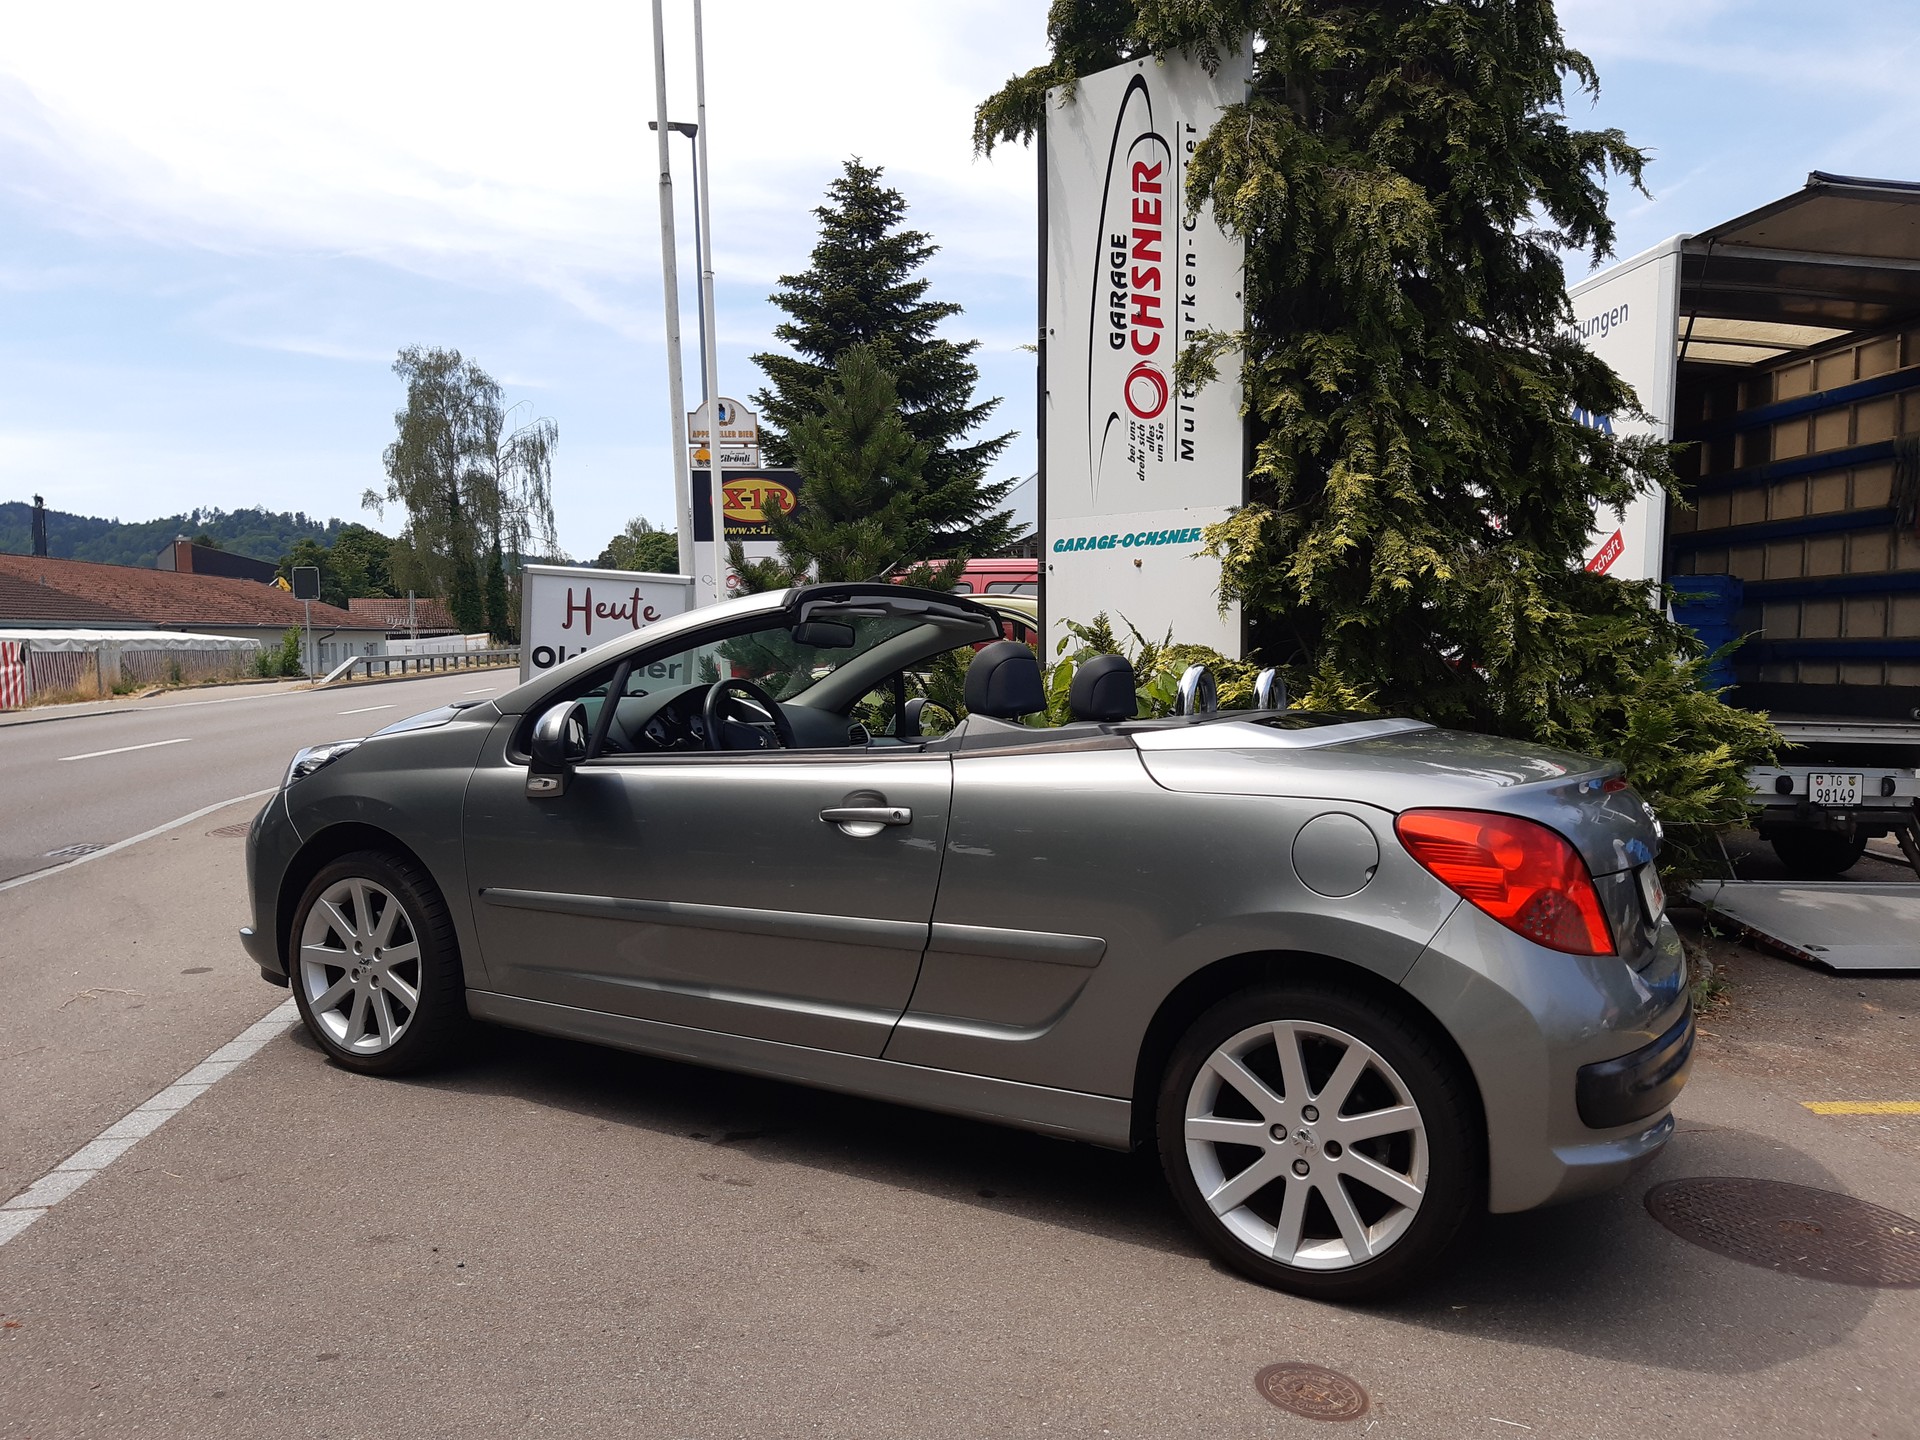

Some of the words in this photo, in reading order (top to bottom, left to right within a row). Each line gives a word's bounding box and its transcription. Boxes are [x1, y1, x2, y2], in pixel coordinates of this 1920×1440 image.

[1110, 233, 1128, 350] GARAGE
[1124, 159, 1169, 420] OCHSNER
[1181, 123, 1197, 462] Multarken-Cer
[1136, 424, 1145, 446] sich
[1146, 424, 1155, 452] alles
[1156, 422, 1164, 442] Sie
[1127, 443, 1136, 464] bei
[1136, 449, 1145, 481] dreht
[1156, 443, 1164, 462] um
[723, 488, 791, 510] X-1R
[1592, 538, 1621, 573] schäft
[562, 587, 662, 636] Heute
[1830, 775, 1843, 786] TG
[1817, 789, 1855, 803] 98149
